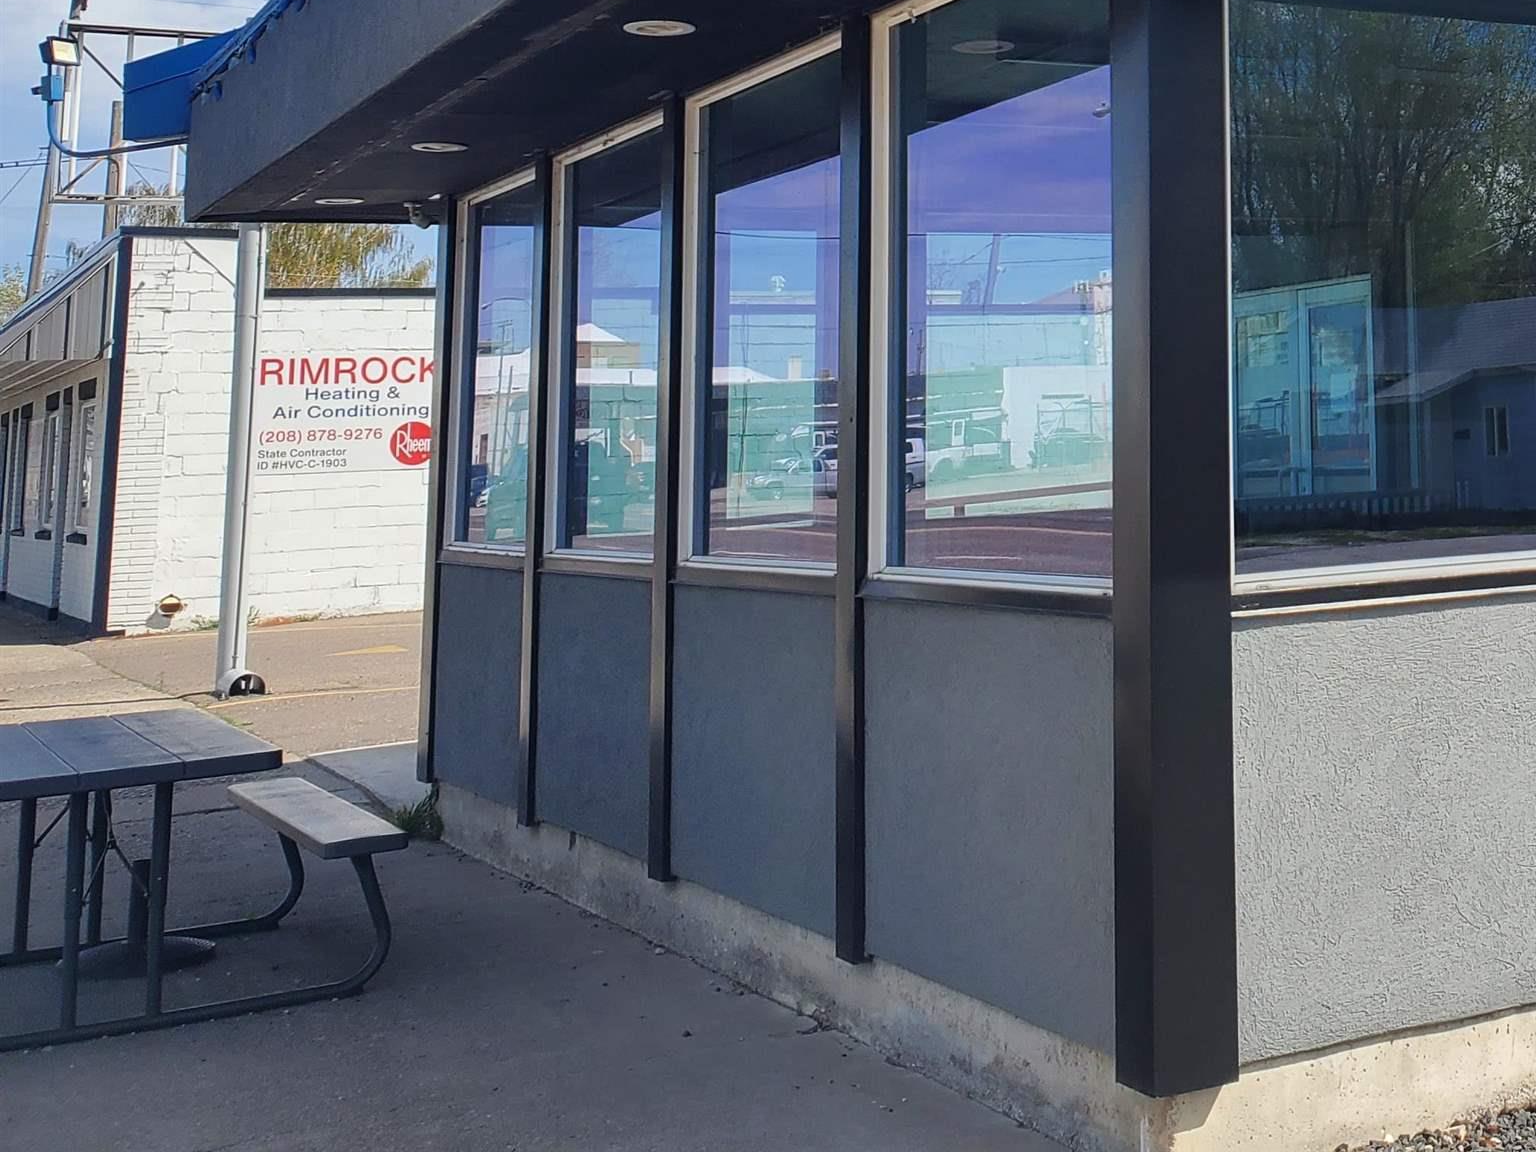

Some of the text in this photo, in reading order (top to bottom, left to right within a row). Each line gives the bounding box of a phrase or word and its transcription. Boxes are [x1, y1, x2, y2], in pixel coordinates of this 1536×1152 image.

[259, 356, 435, 386] RIMROCK
[305, 386, 401, 402] Heating &
[272, 404, 430, 419] Air Conditioning
[259, 428, 383, 445] (208) 878-9276
[257, 448, 347, 459] State Contractor
[257, 458, 348, 470] ID #HVC-C-1903
